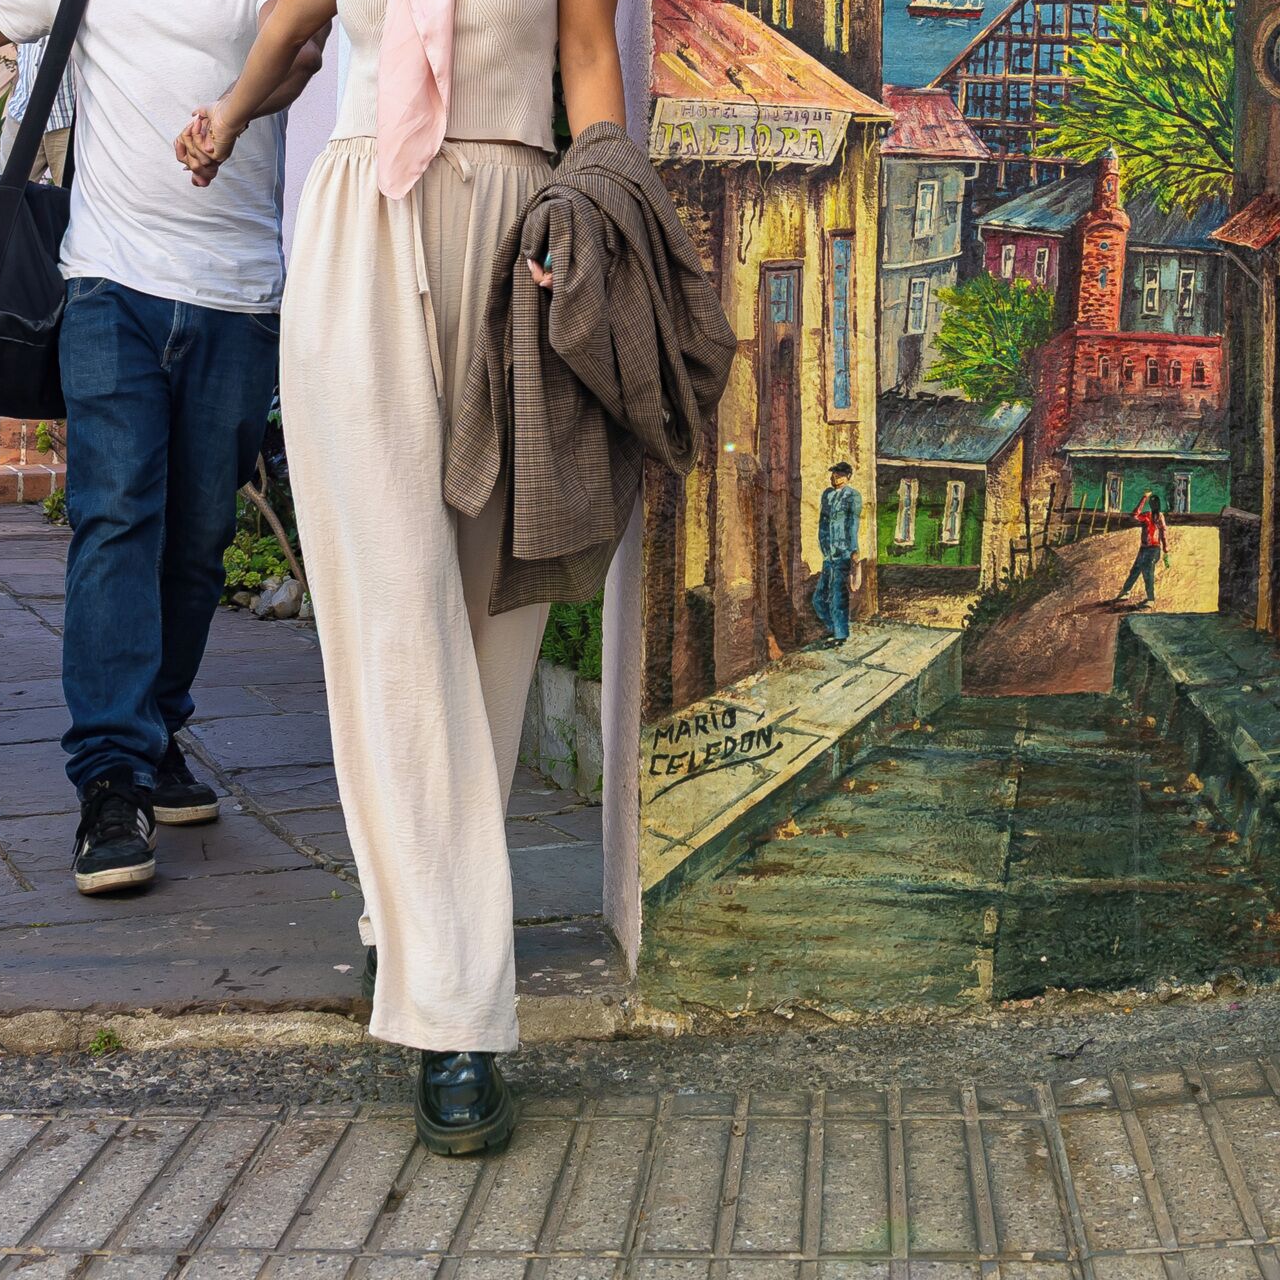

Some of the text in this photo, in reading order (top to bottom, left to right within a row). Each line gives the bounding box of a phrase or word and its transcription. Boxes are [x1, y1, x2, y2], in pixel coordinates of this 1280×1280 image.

[681, 105, 738, 119] HOTEL
[660, 121, 825, 159] LA FLORA
[652, 704, 737, 751] MARIO
